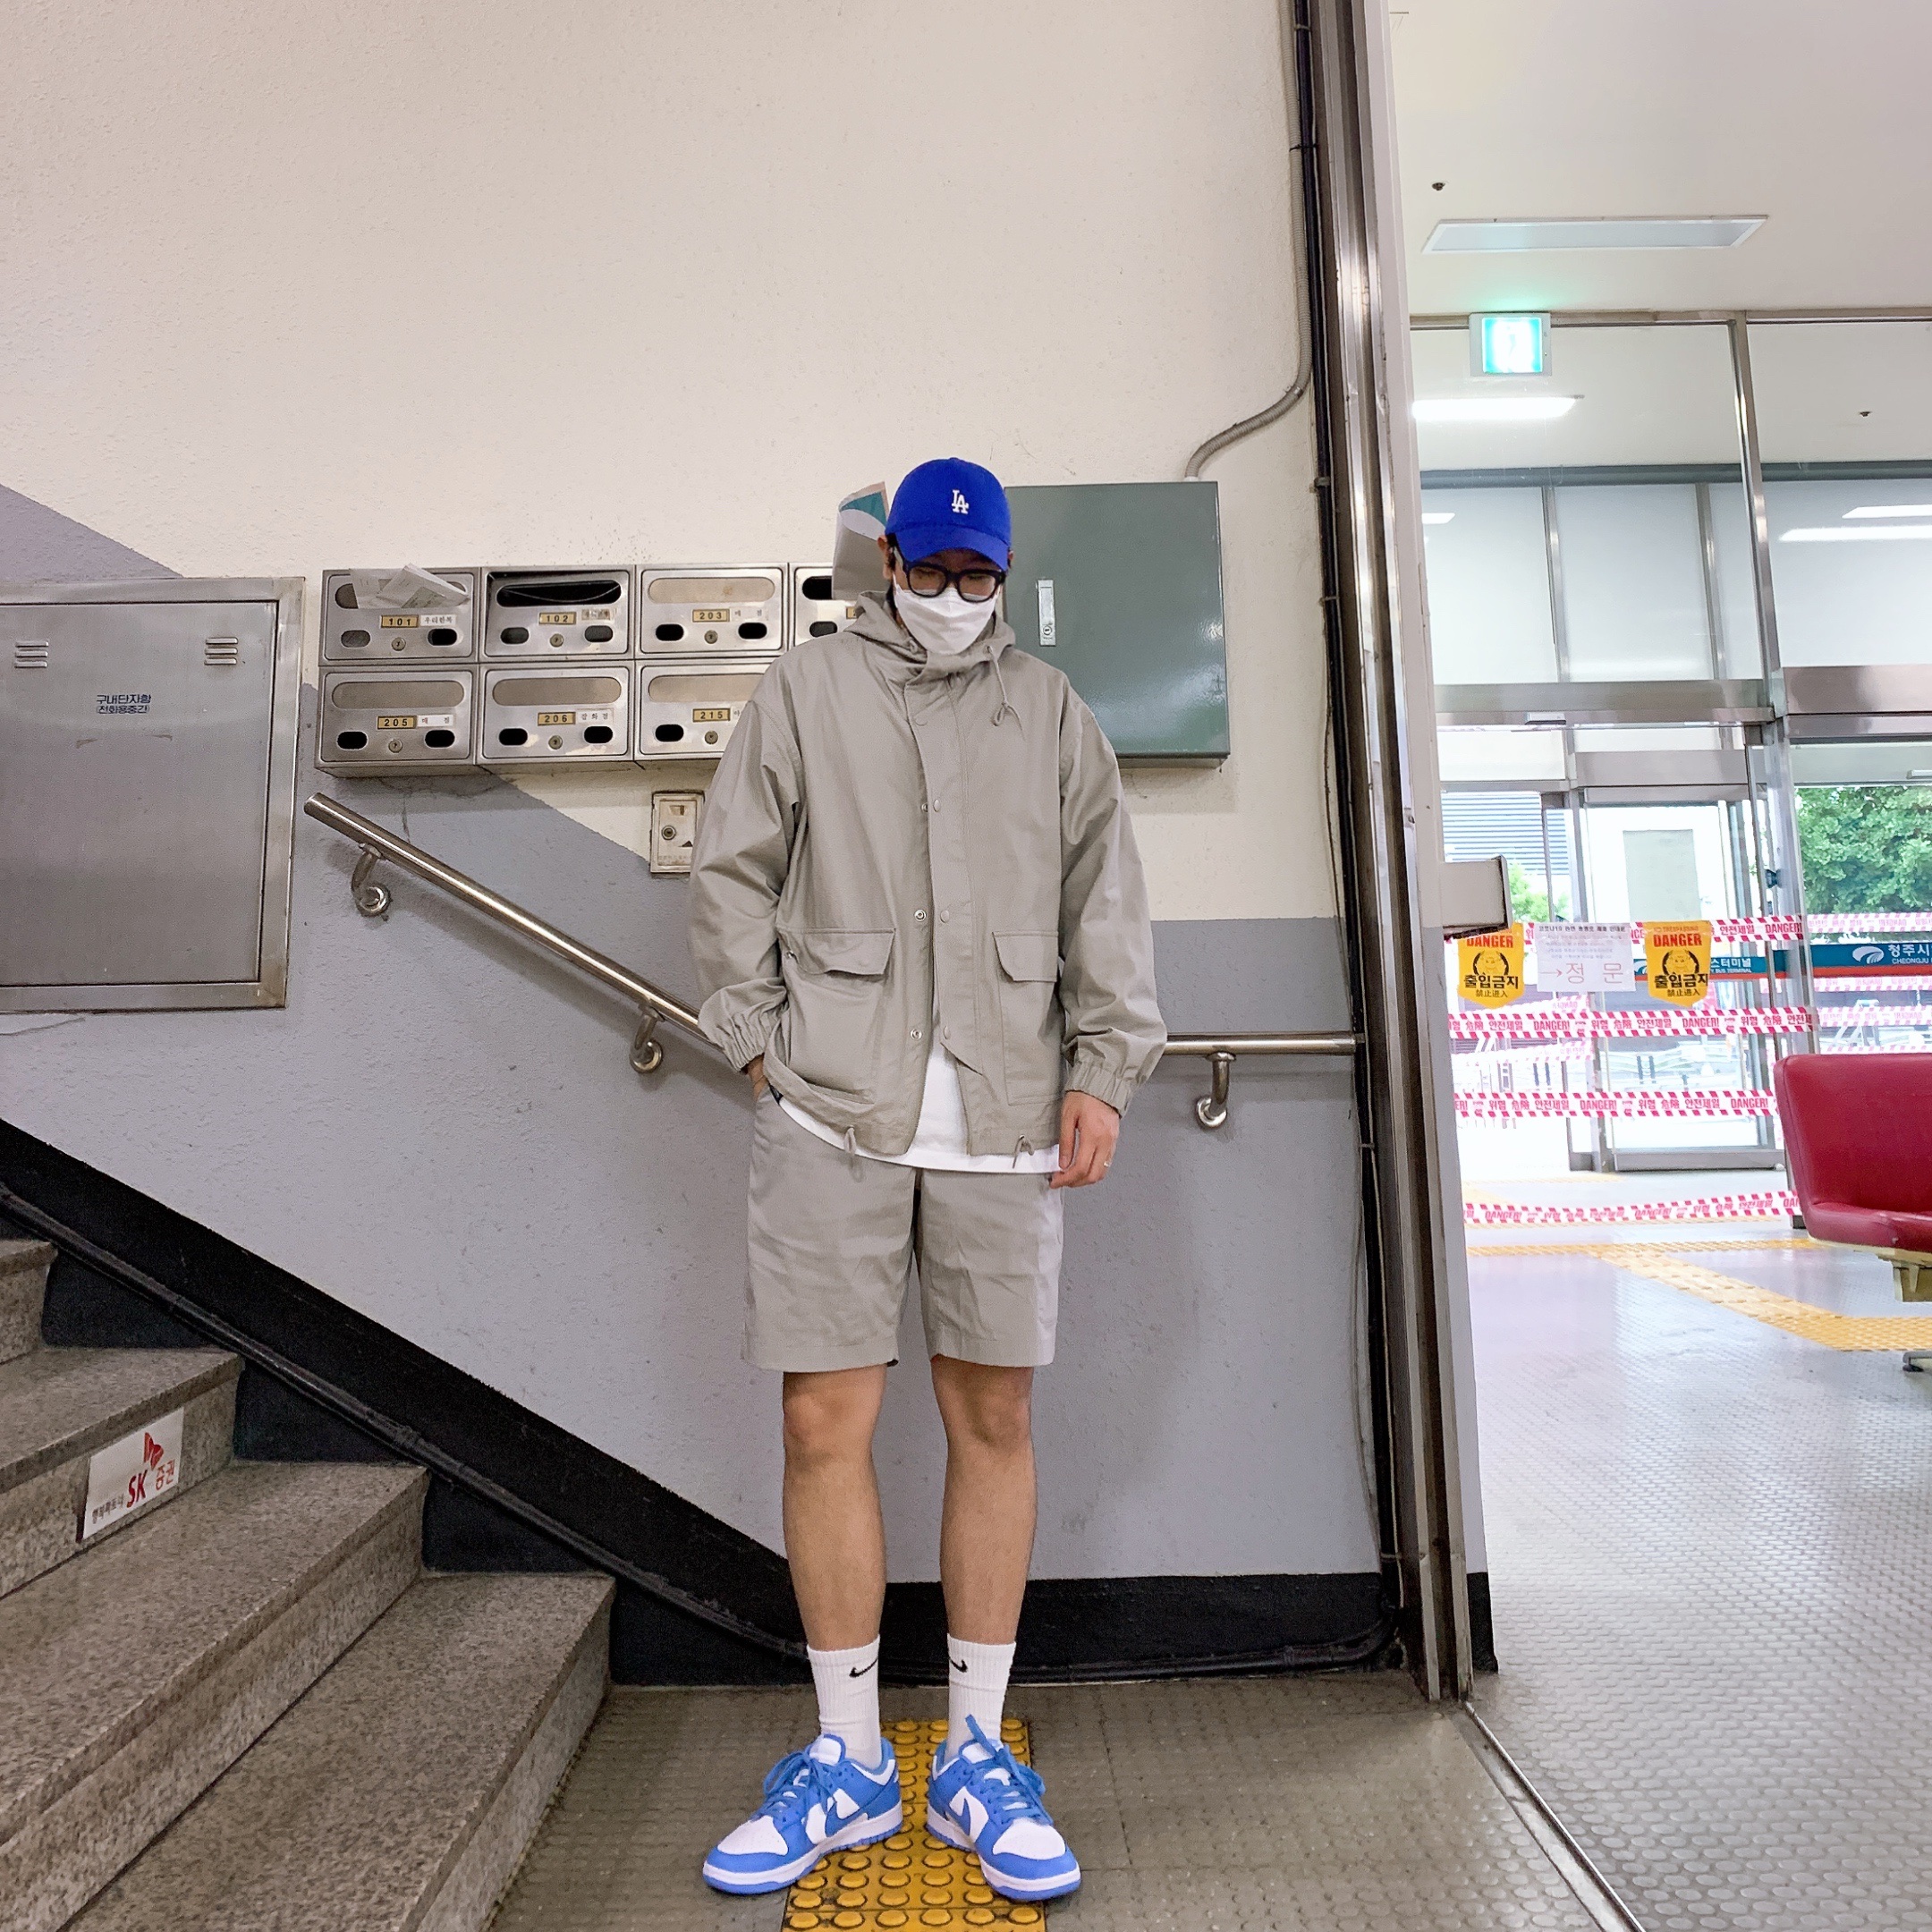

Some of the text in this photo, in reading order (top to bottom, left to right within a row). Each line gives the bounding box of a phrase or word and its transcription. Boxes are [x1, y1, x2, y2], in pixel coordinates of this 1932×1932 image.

[952, 489, 969, 514] LA
[388, 617, 411, 626] 101
[547, 614, 569, 623] 102
[699, 611, 723, 620] 203
[544, 715, 568, 723] 206
[699, 711, 723, 719] 215
[384, 718, 408, 726] 205
[1719, 924, 1755, 936] 안전제일
[1466, 935, 1513, 948] DANGER
[1653, 933, 1702, 947] DANGER
[1887, 944, 1932, 958] 청주시
[1710, 958, 1752, 968] 스터미널
[1892, 957, 1929, 965] CHEONGJU
[1463, 973, 1519, 989] 출입금지
[1654, 972, 1709, 989] 출입금지
[1447, 1020, 1461, 1030] 험
[1488, 1020, 1523, 1030] 안전제일
[1533, 1020, 1571, 1030] DANGER!
[1591, 1019, 1608, 1030] 위험
[1637, 1018, 1672, 1029] 안전제일
[1682, 1017, 1720, 1028] DANGER!
[1741, 1016, 1758, 1026] 위험
[1489, 1099, 1506, 1110] 위험
[1535, 1100, 1569, 1110] 안전제일
[1580, 1099, 1617, 1110] DANGER!
[1639, 1098, 1656, 1109] 위험
[1685, 1098, 1721, 1109] 안전제일
[1731, 1097, 1769, 1109] DANGER!
[126, 1469, 148, 1508] SK
[155, 1460, 175, 1491] 증권
